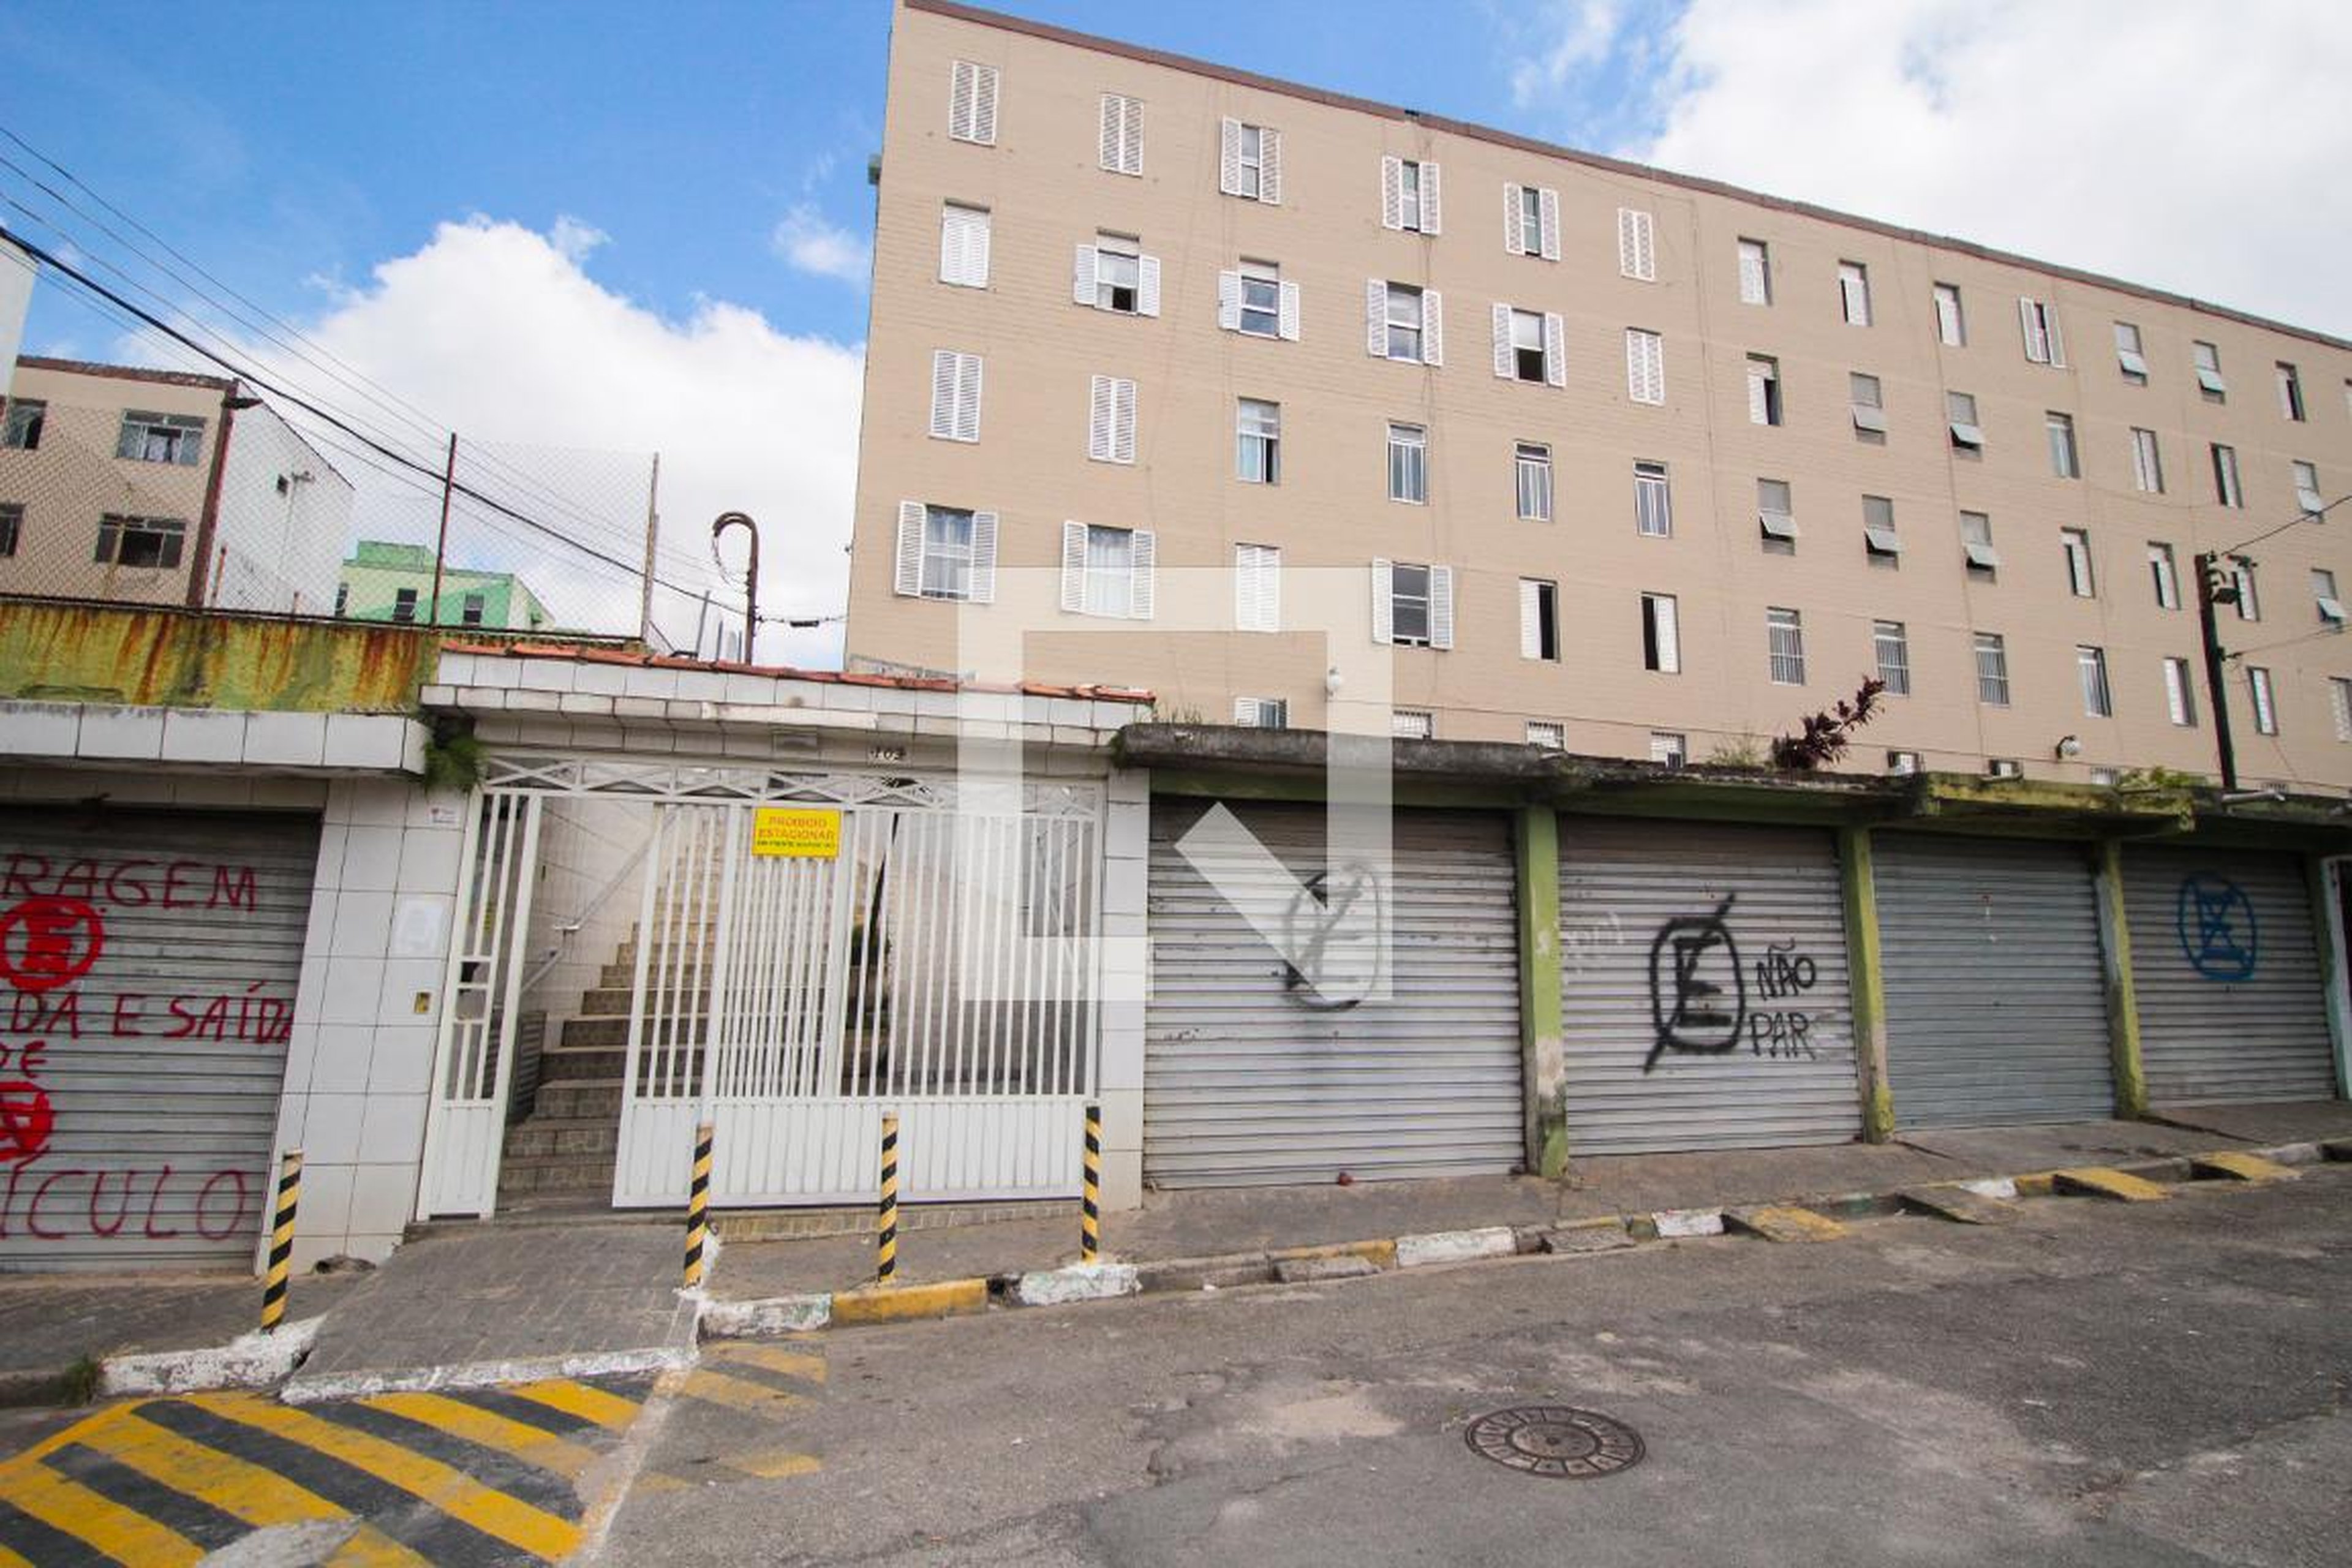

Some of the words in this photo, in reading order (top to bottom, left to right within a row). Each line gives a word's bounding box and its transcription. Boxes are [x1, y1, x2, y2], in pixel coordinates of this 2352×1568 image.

[758, 828, 835, 840] ESTACIONAR
[1756, 937, 1817, 1001] NÃO
[112, 993, 148, 1036] E
